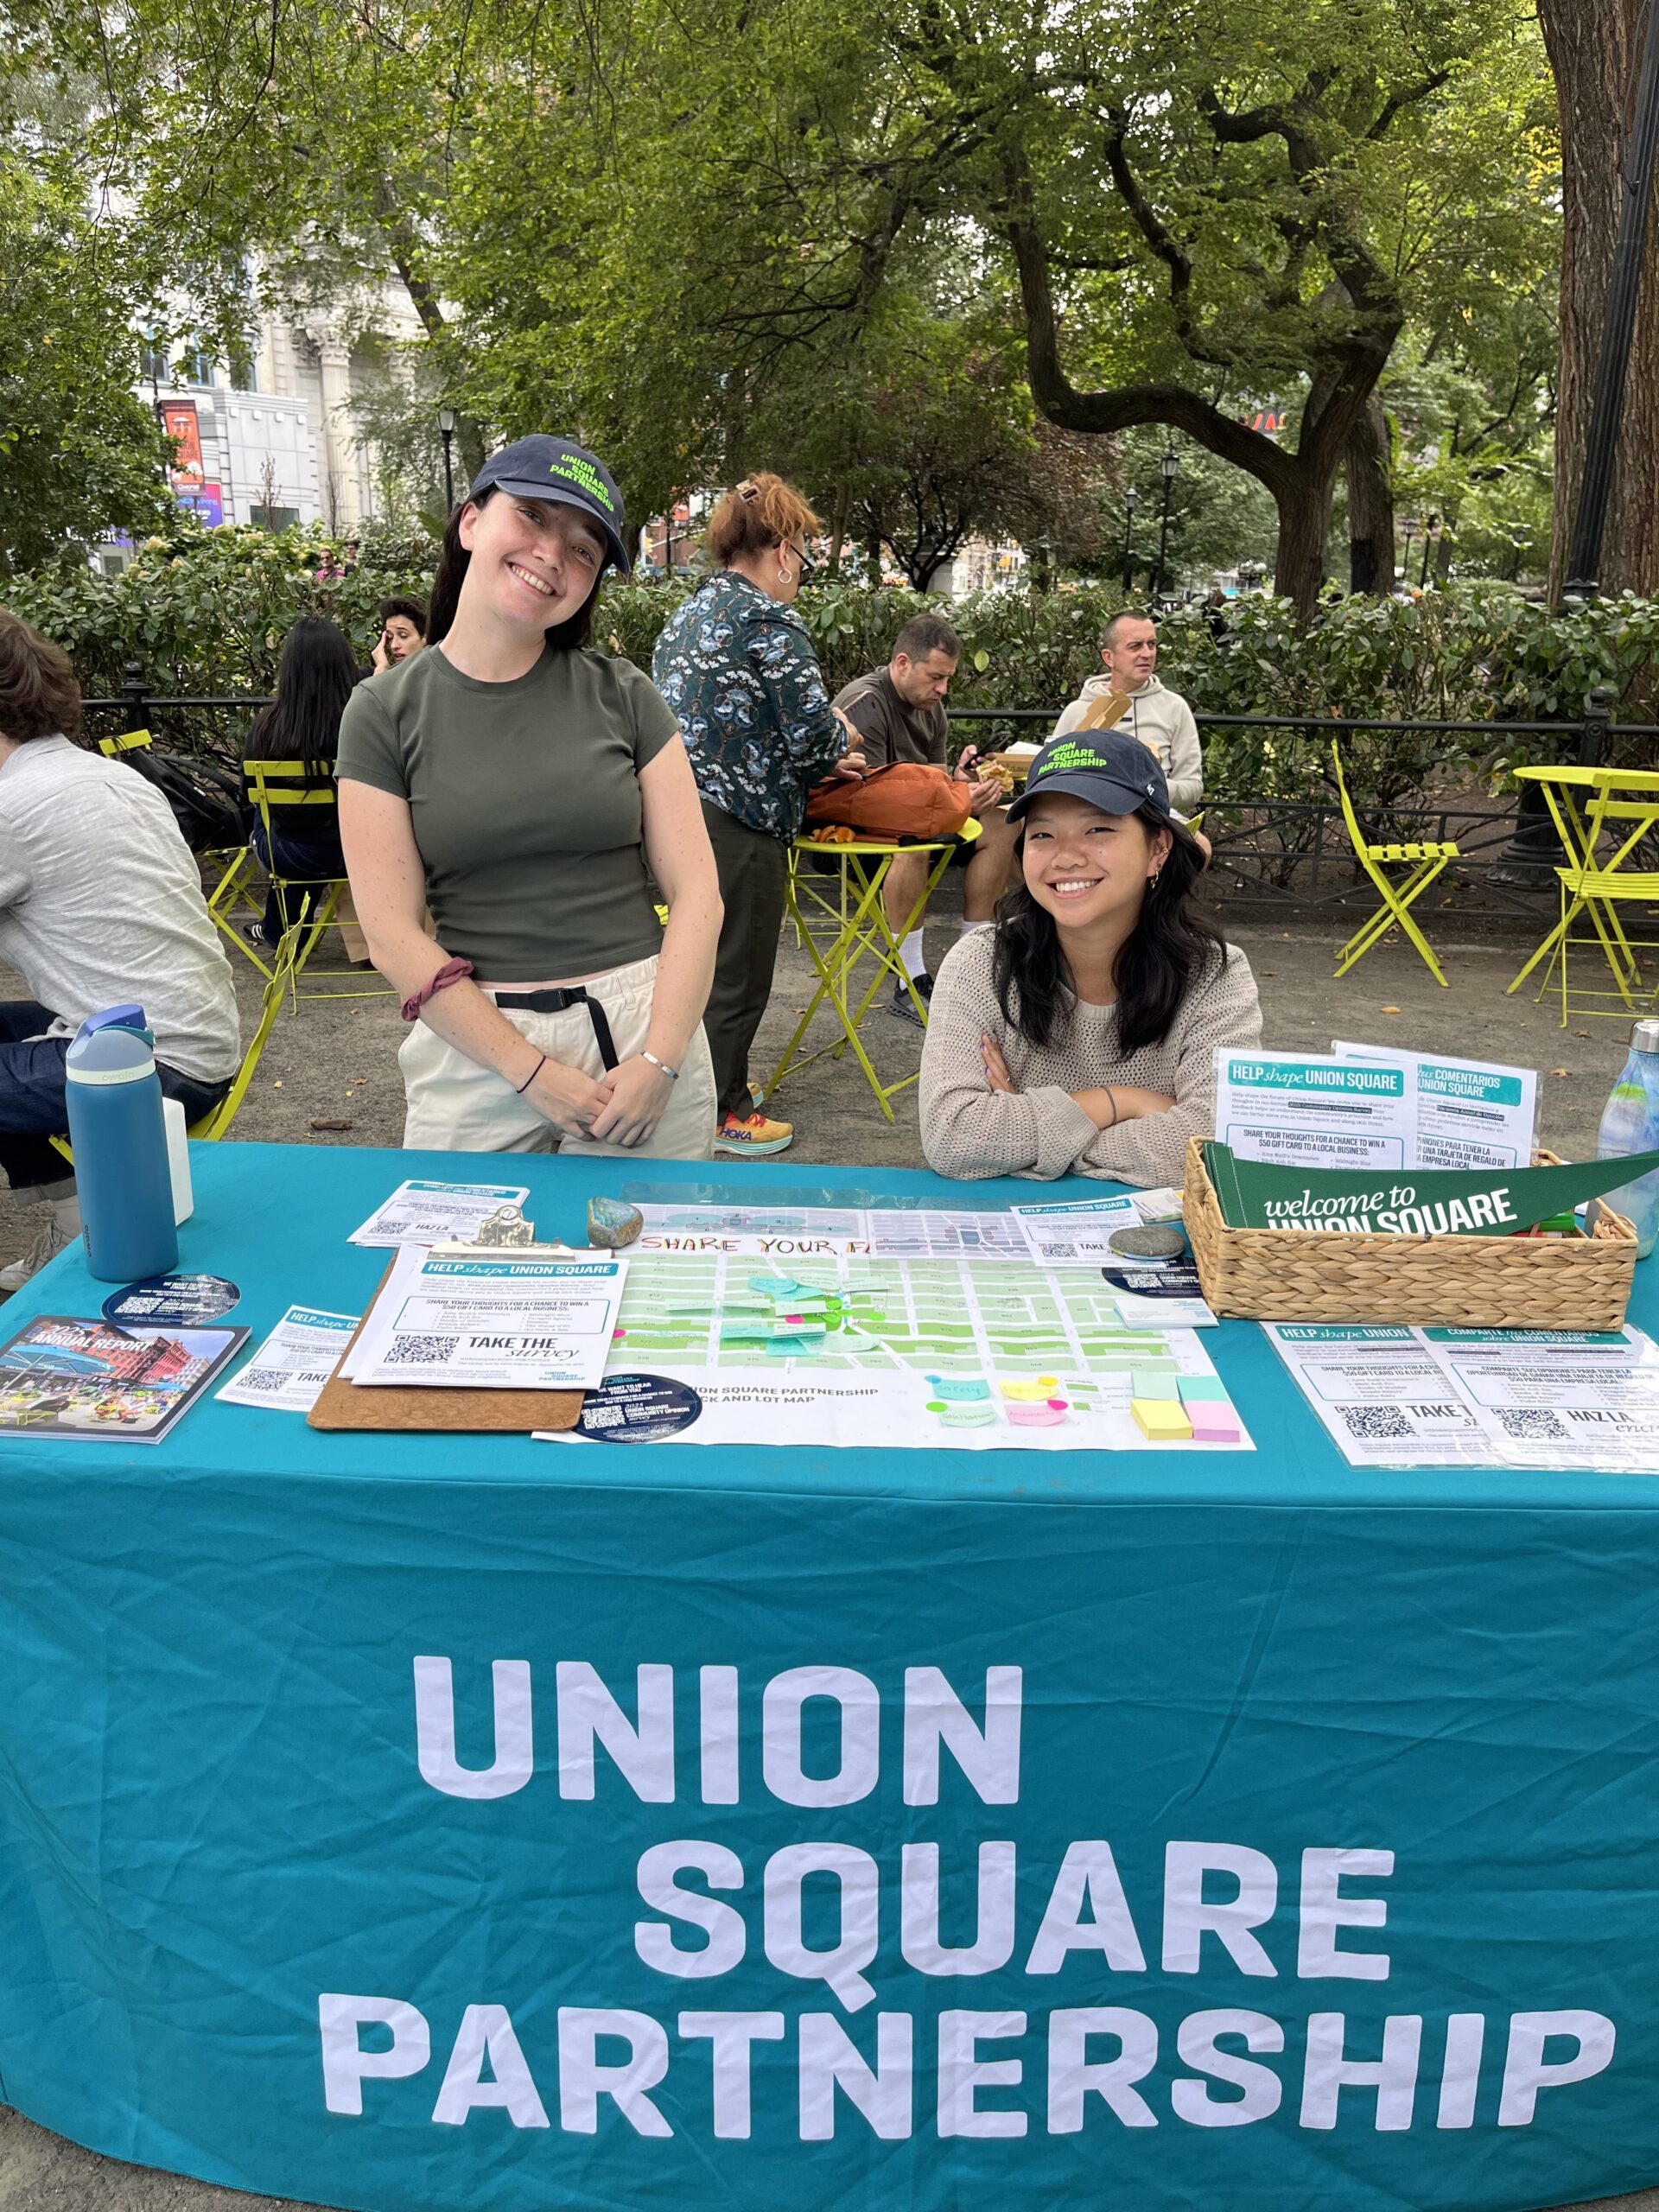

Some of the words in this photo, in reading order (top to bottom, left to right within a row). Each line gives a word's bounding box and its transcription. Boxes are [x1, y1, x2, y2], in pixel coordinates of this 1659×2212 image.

[561, 454, 595, 475] UNION
[550, 465, 614, 512] PARTNERSHIP
[571, 465, 609, 497] SQUARE
[1047, 741, 1076, 757] UNION
[1053, 748, 1095, 762] SQUARE
[1038, 757, 1107, 775] PARTNERSHIP
[101, 1071, 135, 1082] owala
[1232, 1065, 1264, 1080] HELP
[1263, 1068, 1303, 1087] shape
[1305, 1070, 1344, 1086] UNION
[1346, 1072, 1398, 1090] SQUARE
[1435, 1069, 1500, 1089] COMENTARIOS
[1418, 1078, 1446, 1091] UNION
[1448, 1084, 1484, 1097] SQUARE
[719, 1127, 752, 1141] HOKA
[1243, 1129, 1263, 1138] SHARE
[1282, 1133, 1314, 1142] THOUGHTS
[1334, 1136, 1359, 1146] CHANCE
[1259, 1139, 1270, 1147] $50
[1286, 1141, 1302, 1150] CARD
[1318, 1144, 1337, 1153] LOCAL
[1338, 1146, 1369, 1155] BUSINESS:
[1445, 1141, 1461, 1151] PARA
[1462, 1143, 1481, 1154] TENER
[1483, 1147, 1491, 1155] LA
[1422, 1155, 1451, 1166] EMPRESA
[1423, 1146, 1435, 1154] UNA
[1437, 1148, 1463, 1160] TARJETA
[1473, 1154, 1497, 1166] REGALO
[1094, 1201, 1127, 1210] SQUARE
[1263, 1190, 1384, 1217] welcome
[1389, 1185, 1416, 1208] to
[1376, 1188, 1518, 1234] SQUARE
[640, 1236, 741, 1252] SHARE
[758, 1238, 838, 1255] YOUR
[428, 1263, 463, 1272] HELP
[462, 1265, 509, 1276] shape
[510, 1266, 555, 1274] UNION
[555, 1265, 611, 1274] SQUARE
[290, 1312, 316, 1323] HELP
[315, 1319, 347, 1329] shape
[41, 1324, 86, 1334] 2025
[1281, 1328, 1317, 1338] HELP
[1319, 1329, 1362, 1341] shape
[1363, 1329, 1409, 1338] UNION
[29, 1333, 93, 1347] ANNUAL
[95, 1338, 156, 1351] REPORT
[469, 1337, 518, 1348] TAKE
[521, 1338, 558, 1349] THE
[505, 1350, 579, 1361] survey
[297, 1372, 332, 1382] TAKE
[781, 1388, 879, 1396] PARTNERSHIP
[1406, 1405, 1460, 1418] TAKE
[1567, 1410, 1609, 1422] HAZ
[1605, 1412, 1635, 1422] LA
[413, 1656, 1023, 1808] UNION
[634, 1840, 1395, 2013] SQUARE
[318, 1993, 1617, 2139] PARTNERSHIP
